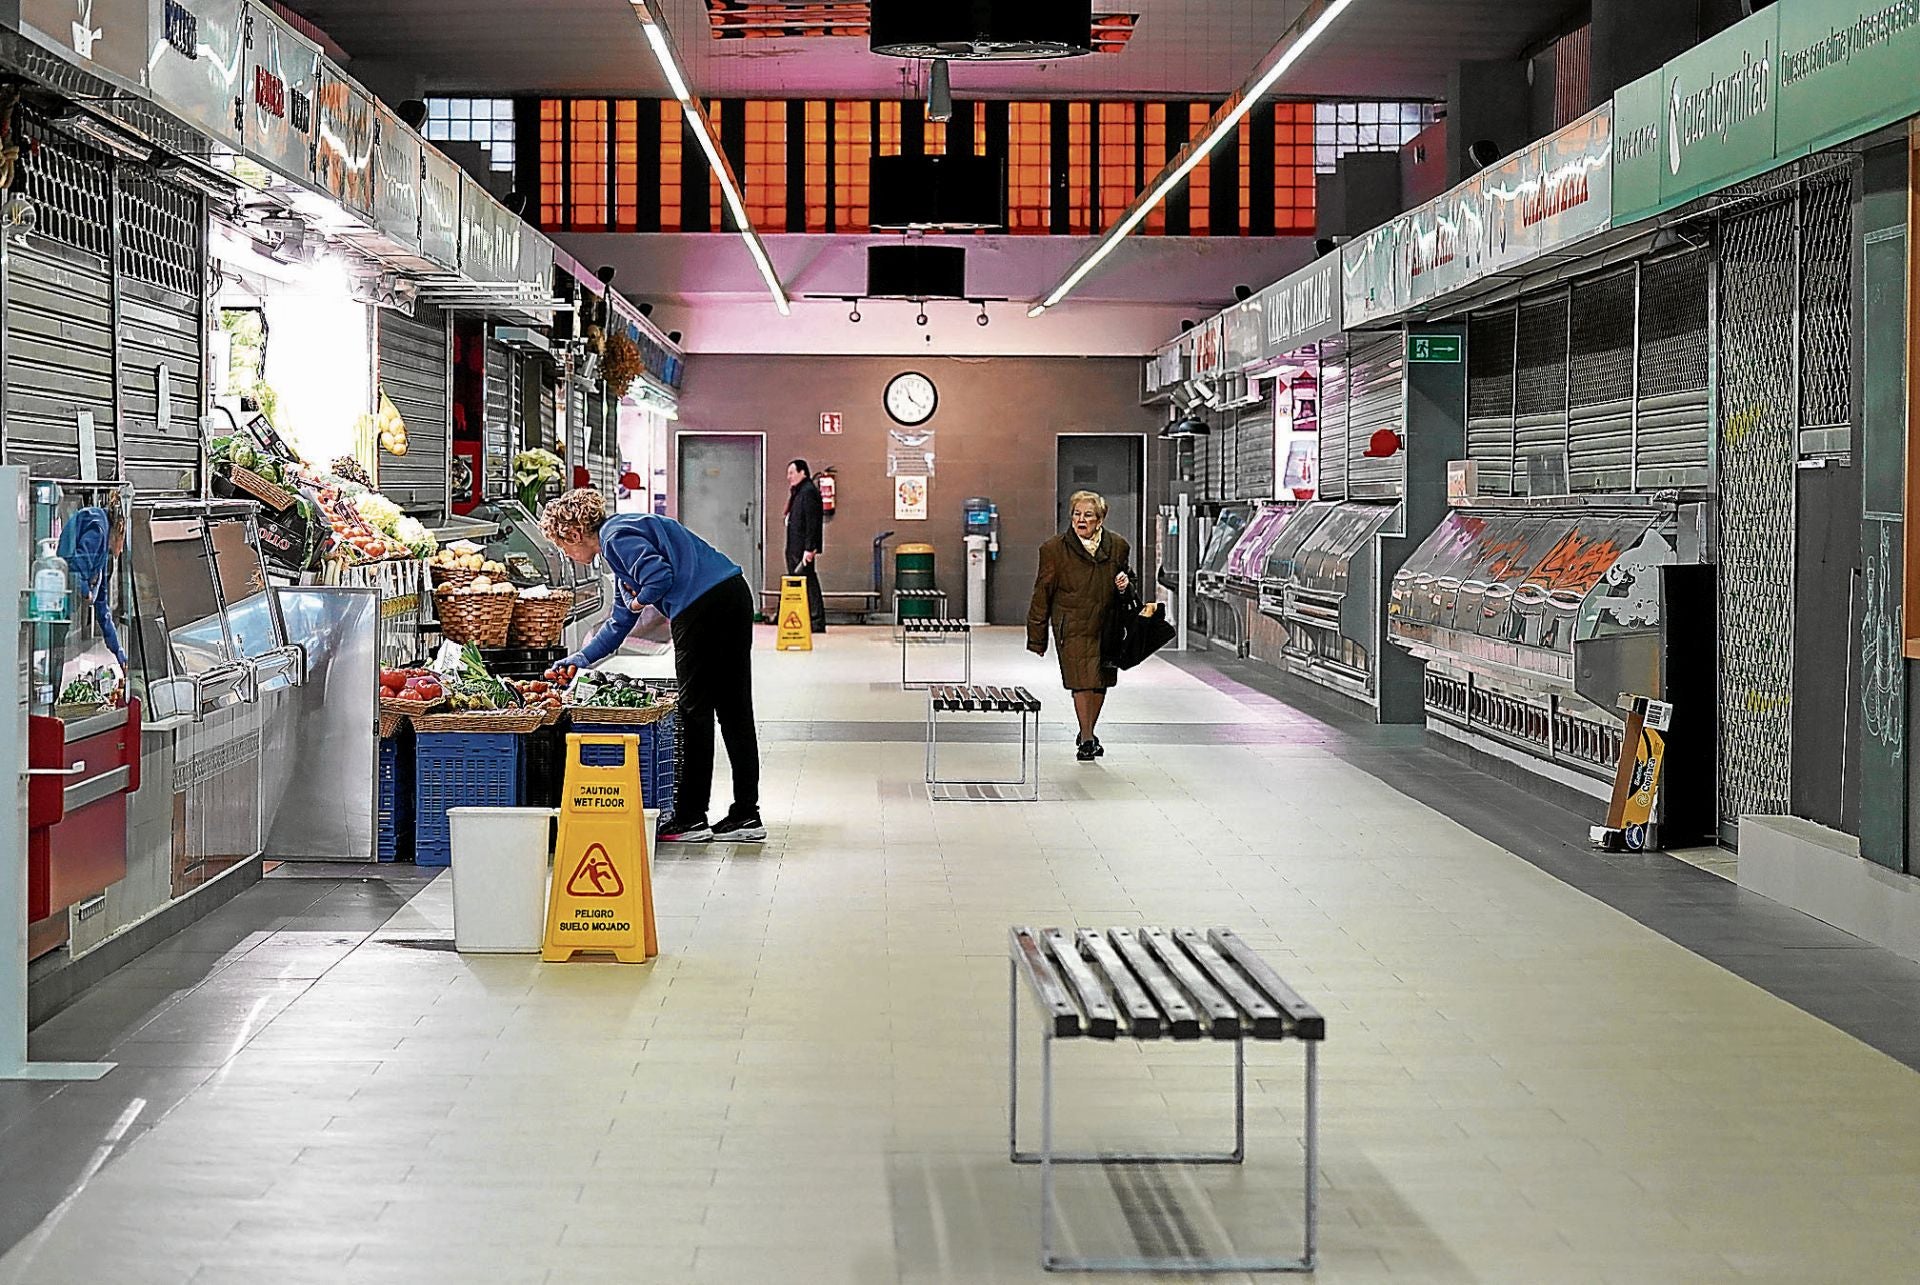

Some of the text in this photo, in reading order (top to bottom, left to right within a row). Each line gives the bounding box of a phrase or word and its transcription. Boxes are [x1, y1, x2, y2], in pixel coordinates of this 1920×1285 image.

[1781, 50, 1809, 88] Quesos
[1809, 40, 1825, 75] con
[1825, 26, 1846, 67] alma
[1846, 26, 1854, 66] y
[1853, 13, 1877, 53] otras
[1683, 39, 1770, 147] cuartoymitad
[573, 797, 625, 808] WET FLOOR
[575, 909, 614, 919] PELIGRO
[559, 922, 631, 932] SUELO MOJADO
